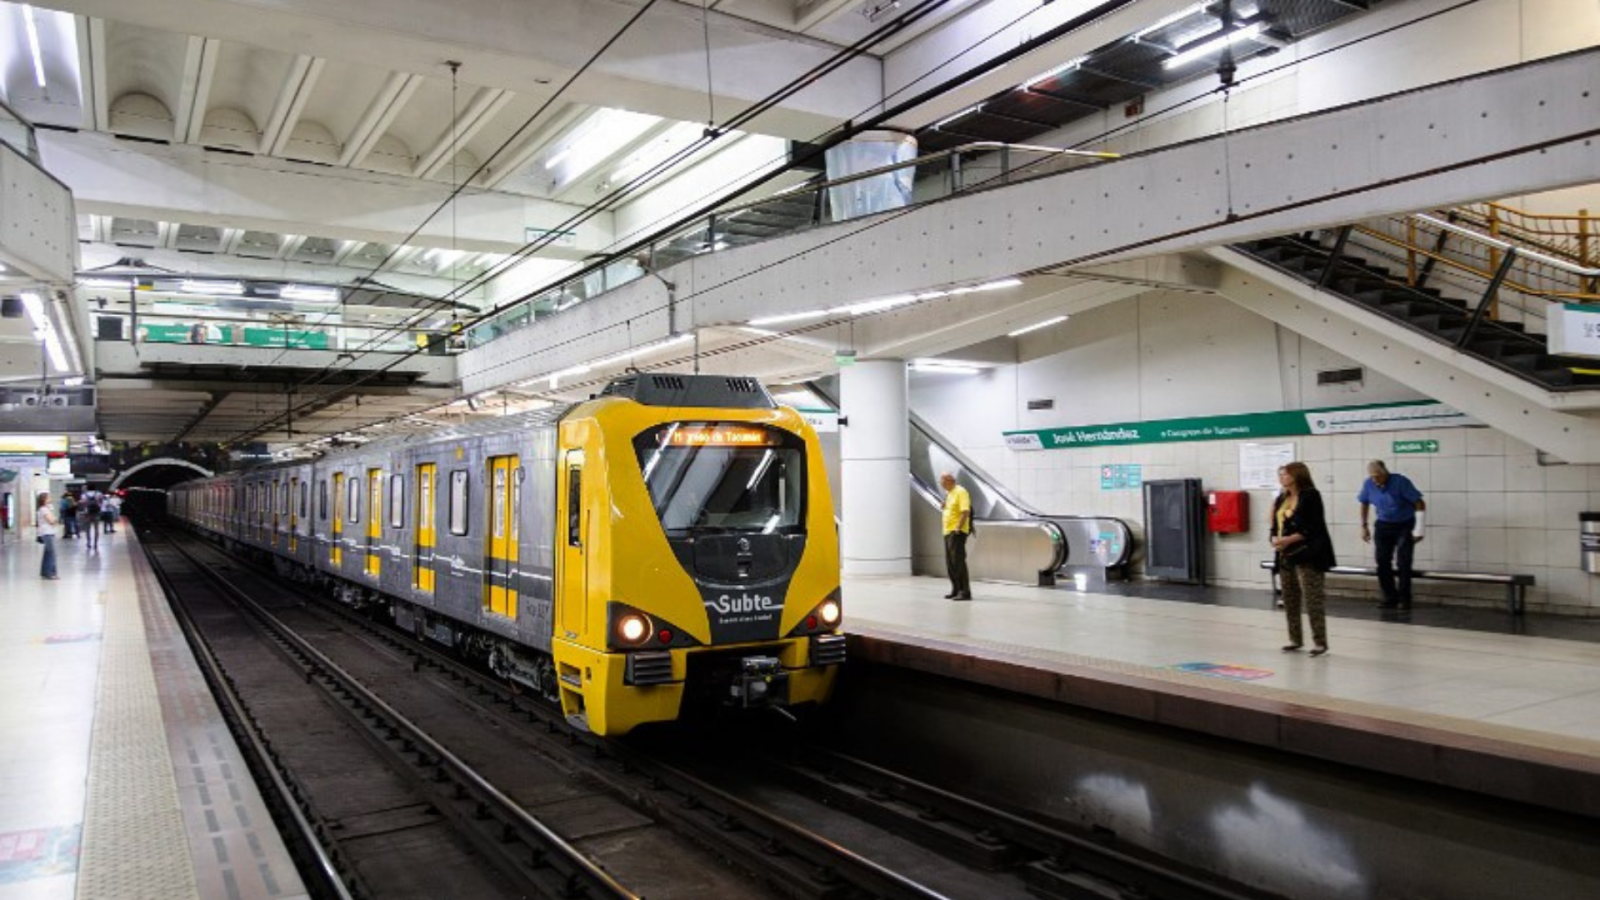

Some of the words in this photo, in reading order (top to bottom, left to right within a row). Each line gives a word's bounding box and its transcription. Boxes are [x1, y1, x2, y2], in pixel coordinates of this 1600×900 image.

[1053, 431, 1076, 444] José
[1077, 427, 1140, 442] Hernández
[717, 593, 773, 614] Subte
